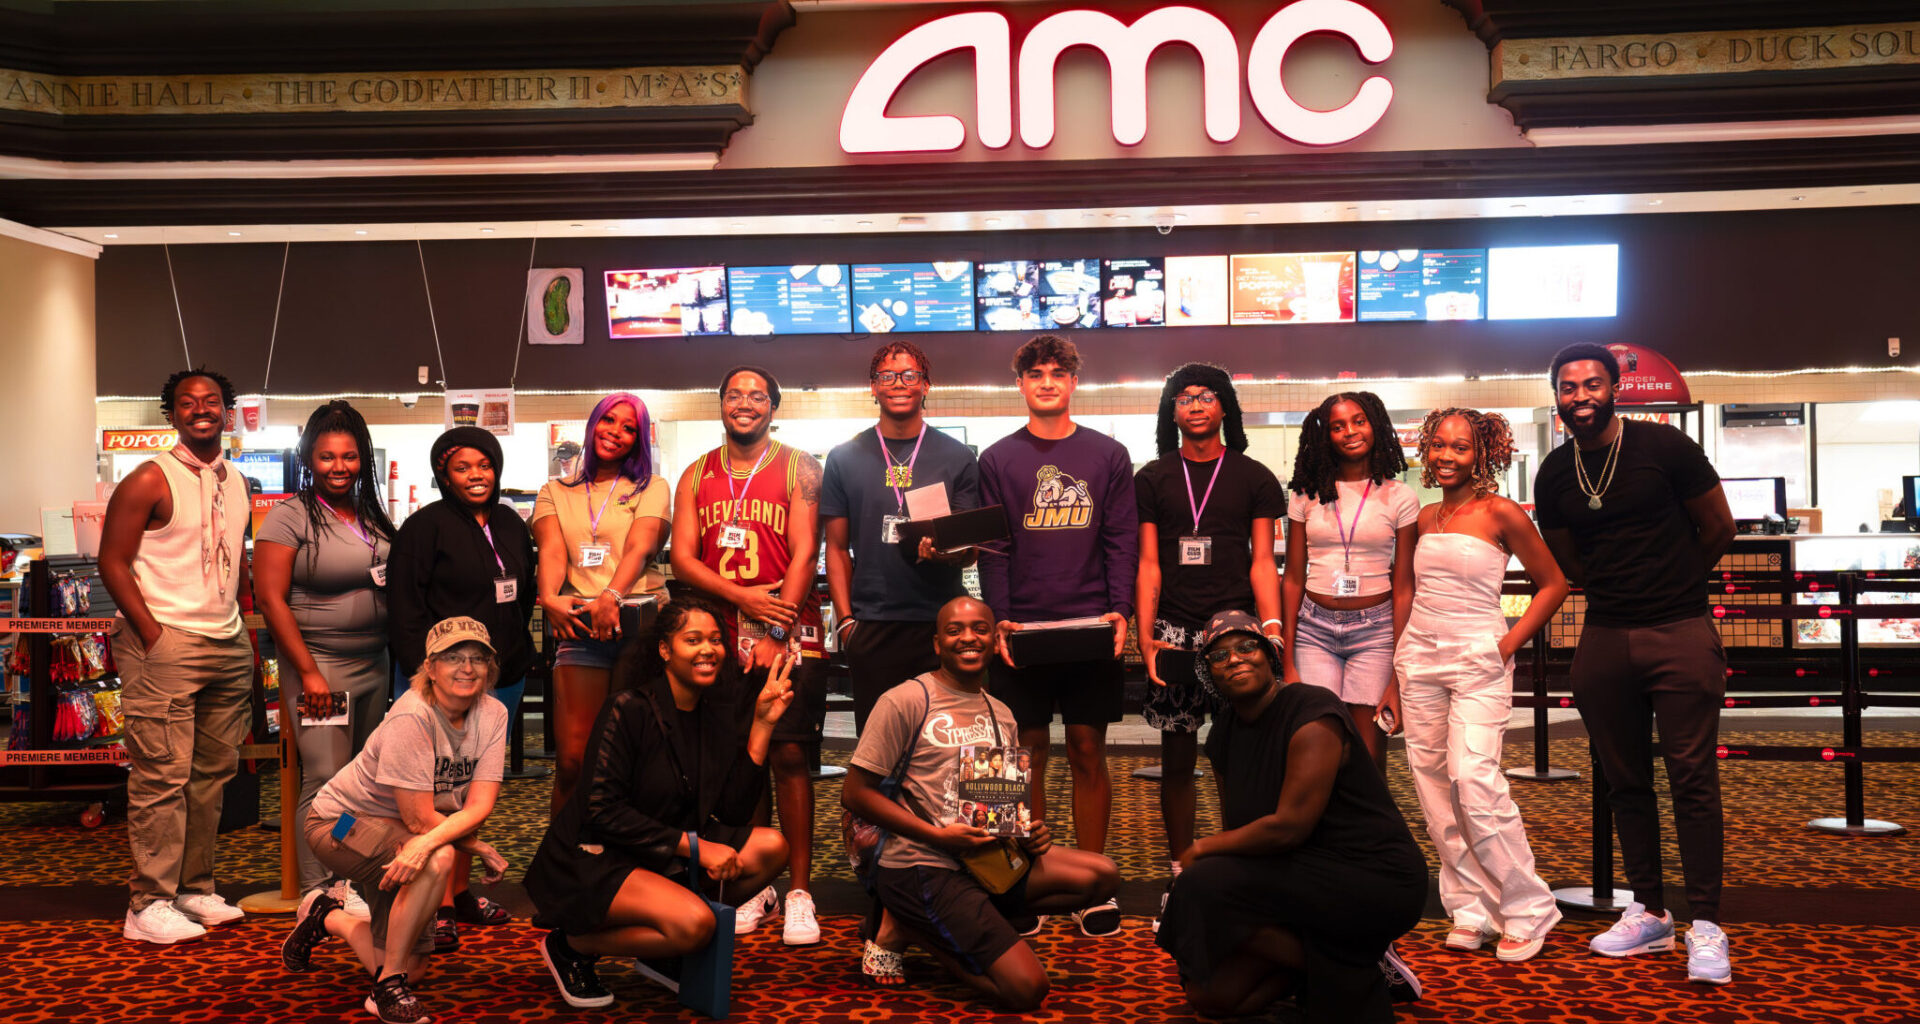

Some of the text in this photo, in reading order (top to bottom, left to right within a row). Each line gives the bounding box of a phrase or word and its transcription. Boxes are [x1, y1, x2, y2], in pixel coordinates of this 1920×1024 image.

[1551, 41, 1678, 70] FARGO
[1728, 33, 1837, 64] DUCK
[6, 78, 224, 106] ANNIE HALL
[268, 76, 590, 104] THE GODFATHER II
[1637, 382, 1672, 390] HERE
[108, 434, 178, 448] POPCO
[699, 499, 785, 537] CLEVELAND
[1026, 505, 1091, 528] JMU
[719, 530, 760, 580] 23
[9, 620, 112, 630] PREMIERE MEMBER
[6, 752, 61, 763] PREMIERE
[64, 751, 110, 762] MEMBER
